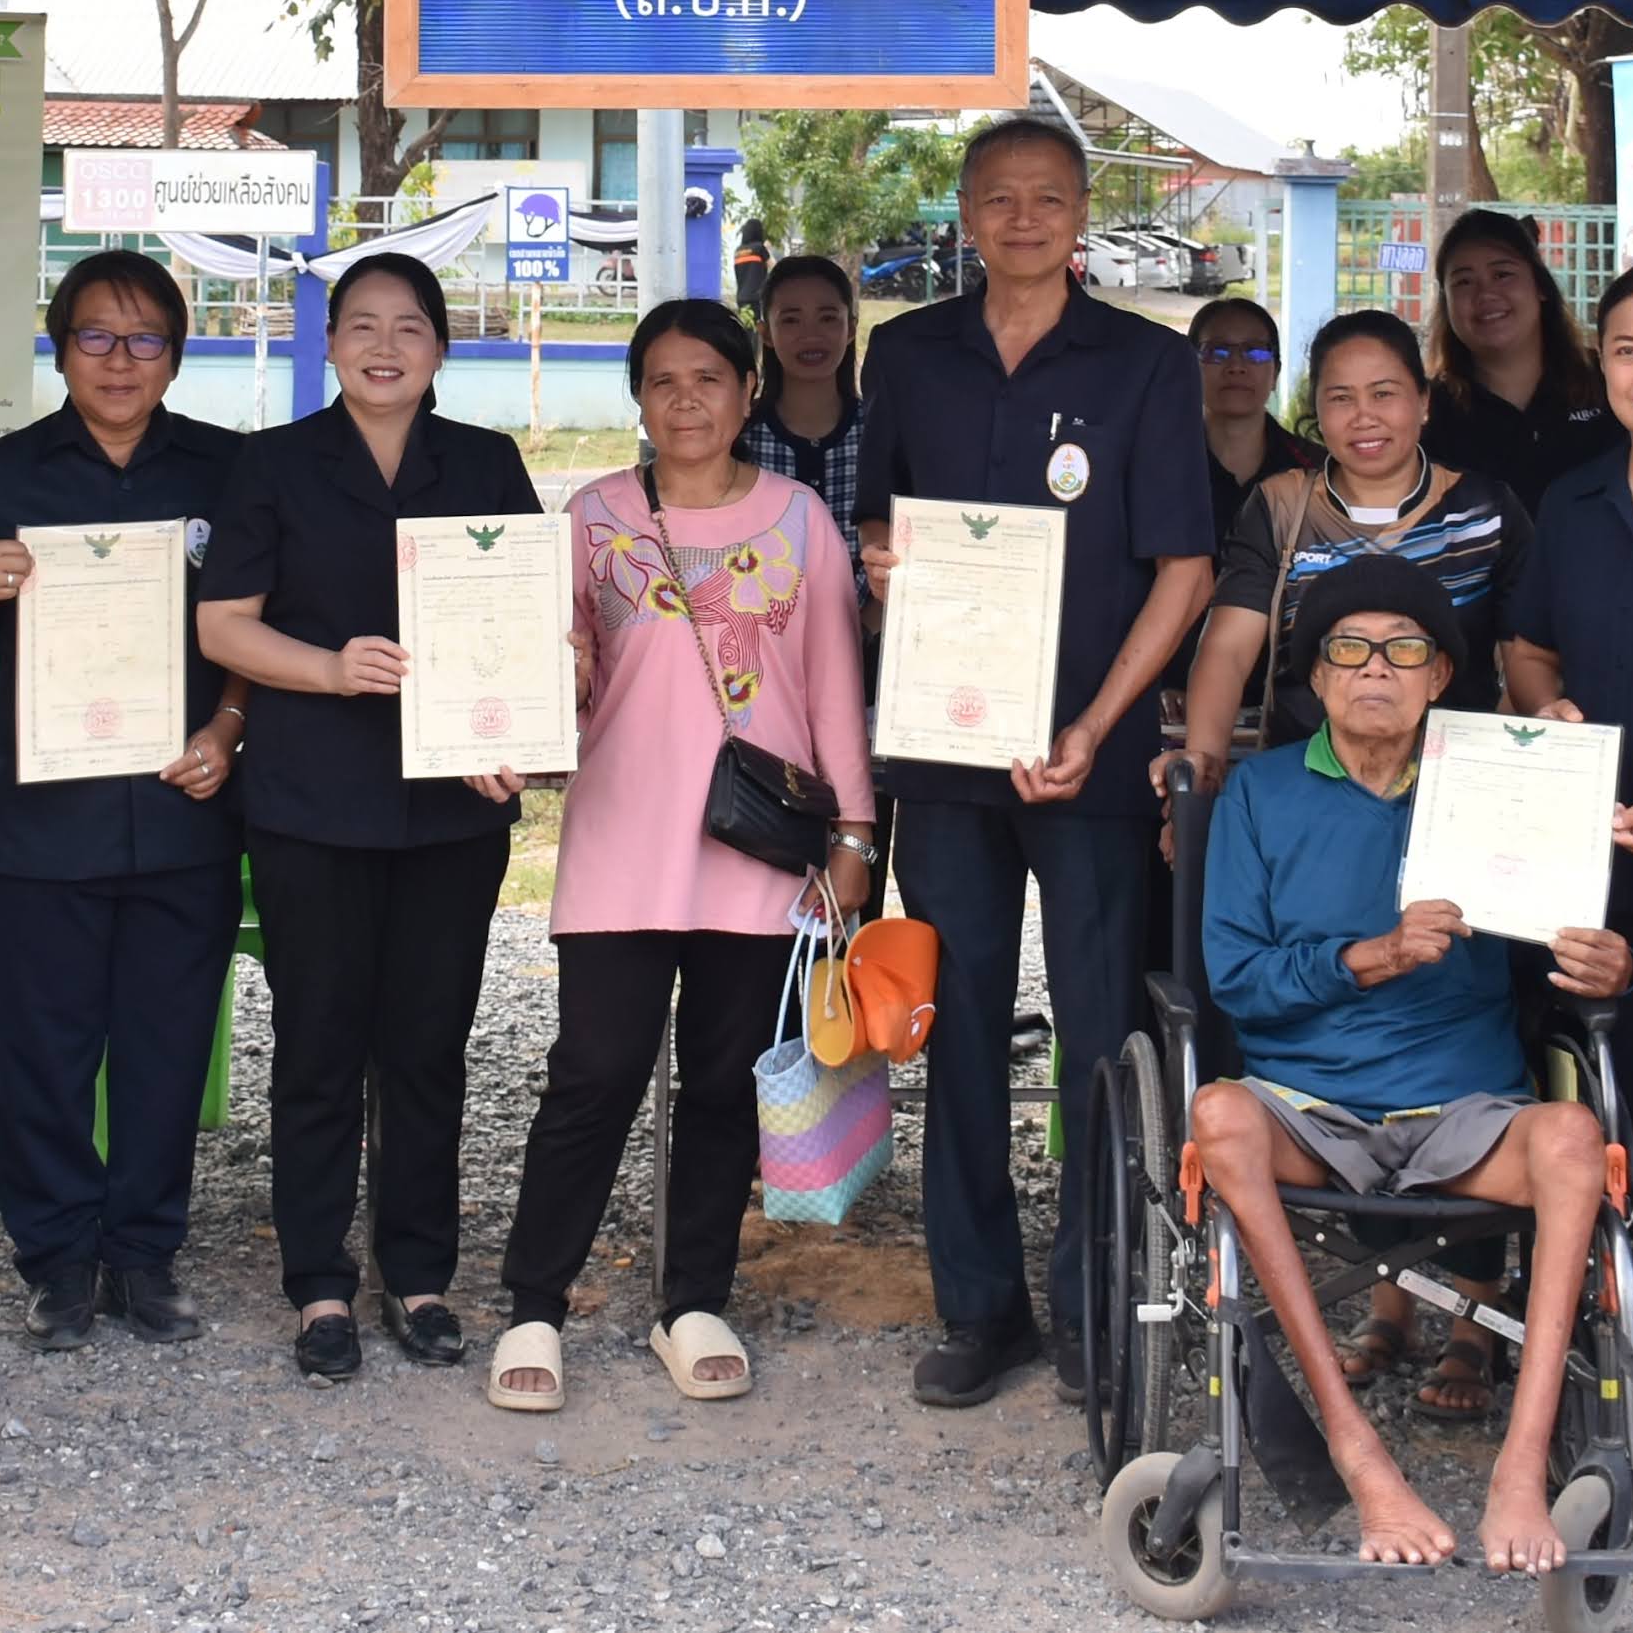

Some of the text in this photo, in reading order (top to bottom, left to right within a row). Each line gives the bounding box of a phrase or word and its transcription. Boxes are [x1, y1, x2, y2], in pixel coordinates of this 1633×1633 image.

[81, 188, 147, 208] 1300
[154, 173, 310, 213] ศูนย์ช่วยเหลือสังคม
[513, 259, 560, 278] 100%
[1381, 245, 1426, 271] ทางออก
